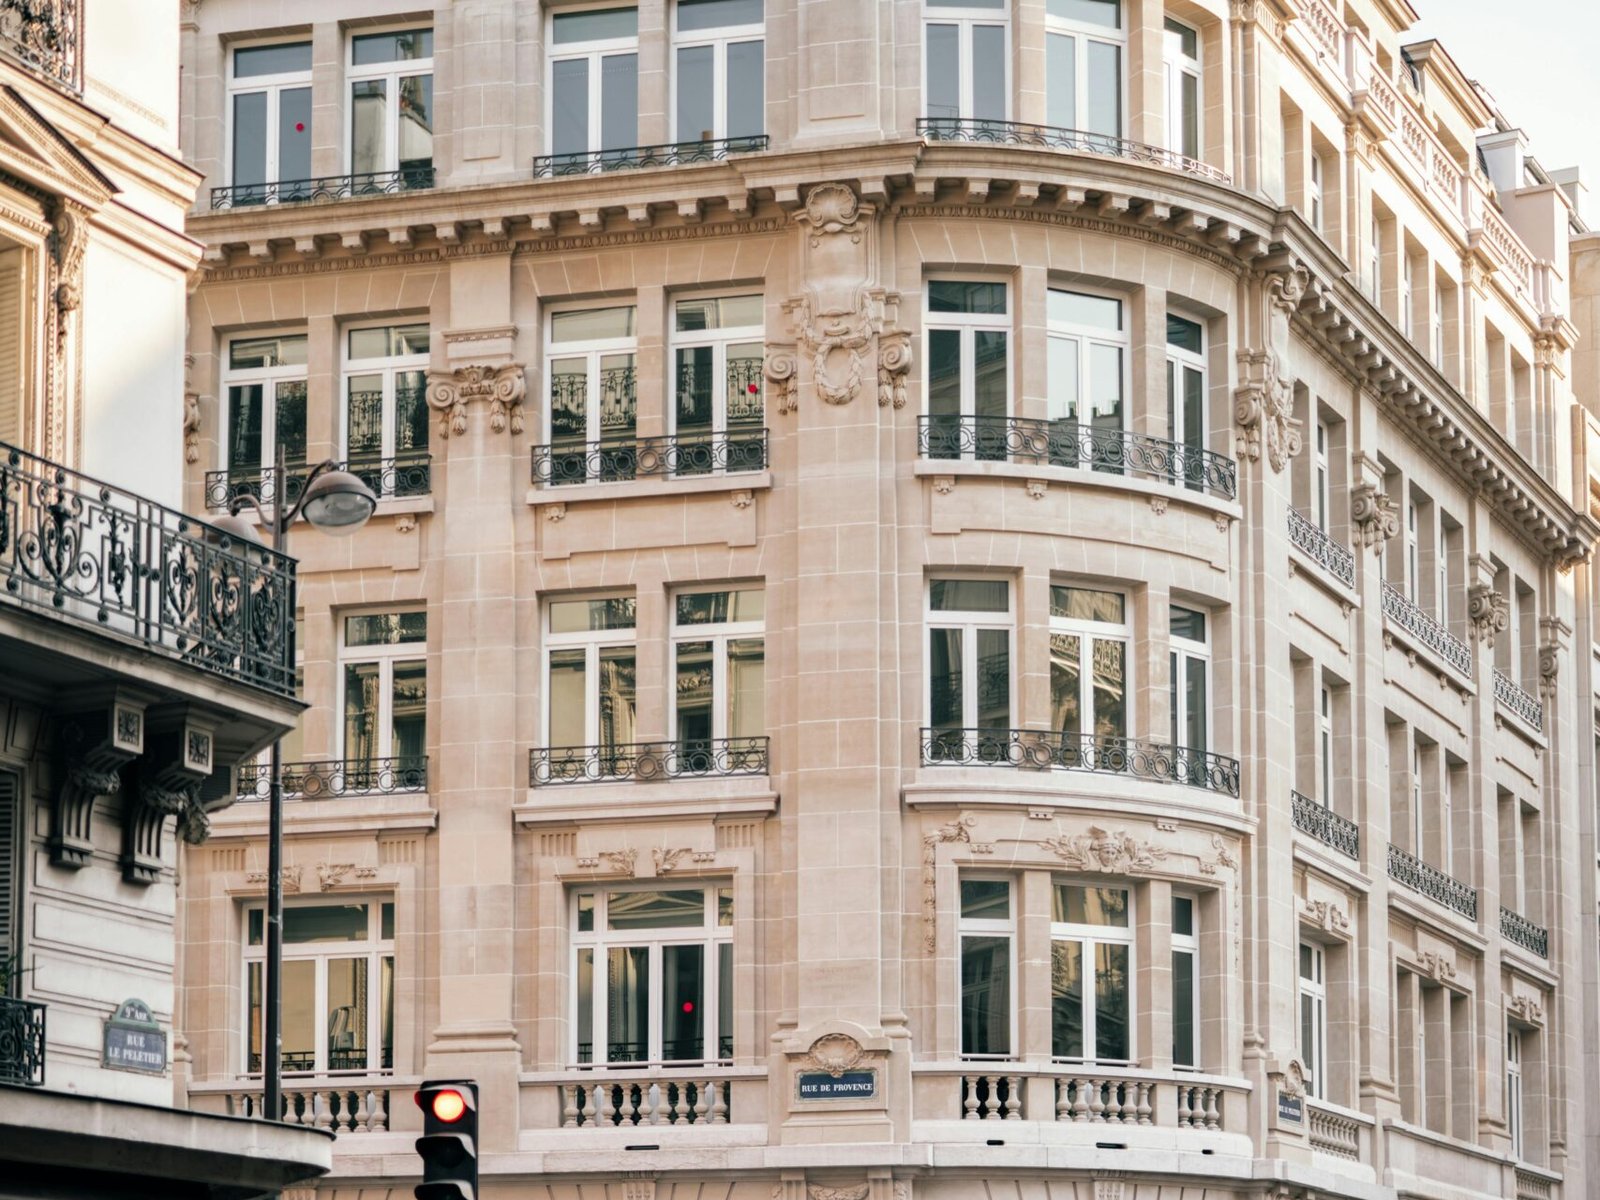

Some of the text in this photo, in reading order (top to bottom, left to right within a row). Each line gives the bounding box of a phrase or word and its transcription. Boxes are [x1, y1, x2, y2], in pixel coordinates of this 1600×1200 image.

[127, 1034, 145, 1048] RUE
[109, 1046, 162, 1065] LE PELETIER
[802, 1083, 873, 1093] RUE DE PROVENCE
